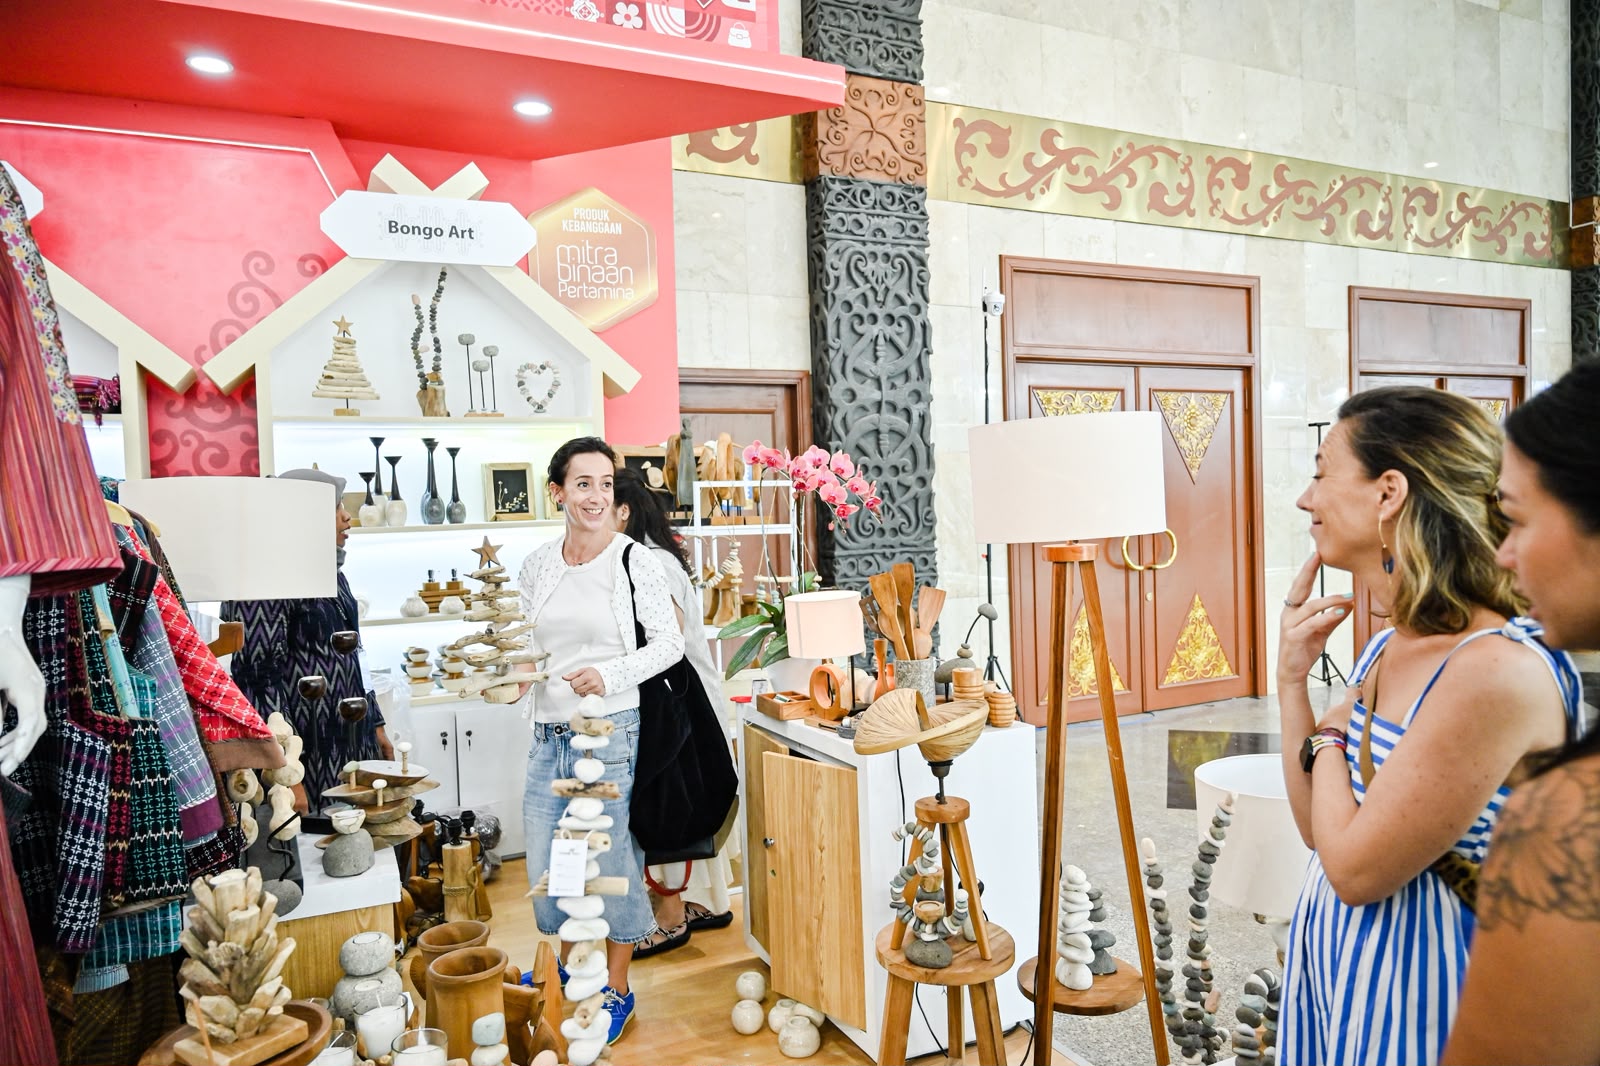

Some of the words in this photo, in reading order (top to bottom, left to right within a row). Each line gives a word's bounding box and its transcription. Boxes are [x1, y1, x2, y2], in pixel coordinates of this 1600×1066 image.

[573, 207, 610, 221] PRODUK
[388, 219, 444, 240] Bongo
[448, 225, 475, 240] Art
[561, 219, 622, 235] KEBANGGAAN
[556, 239, 618, 265] mitra
[556, 259, 634, 285] binaan
[558, 281, 635, 300] Pertamina
